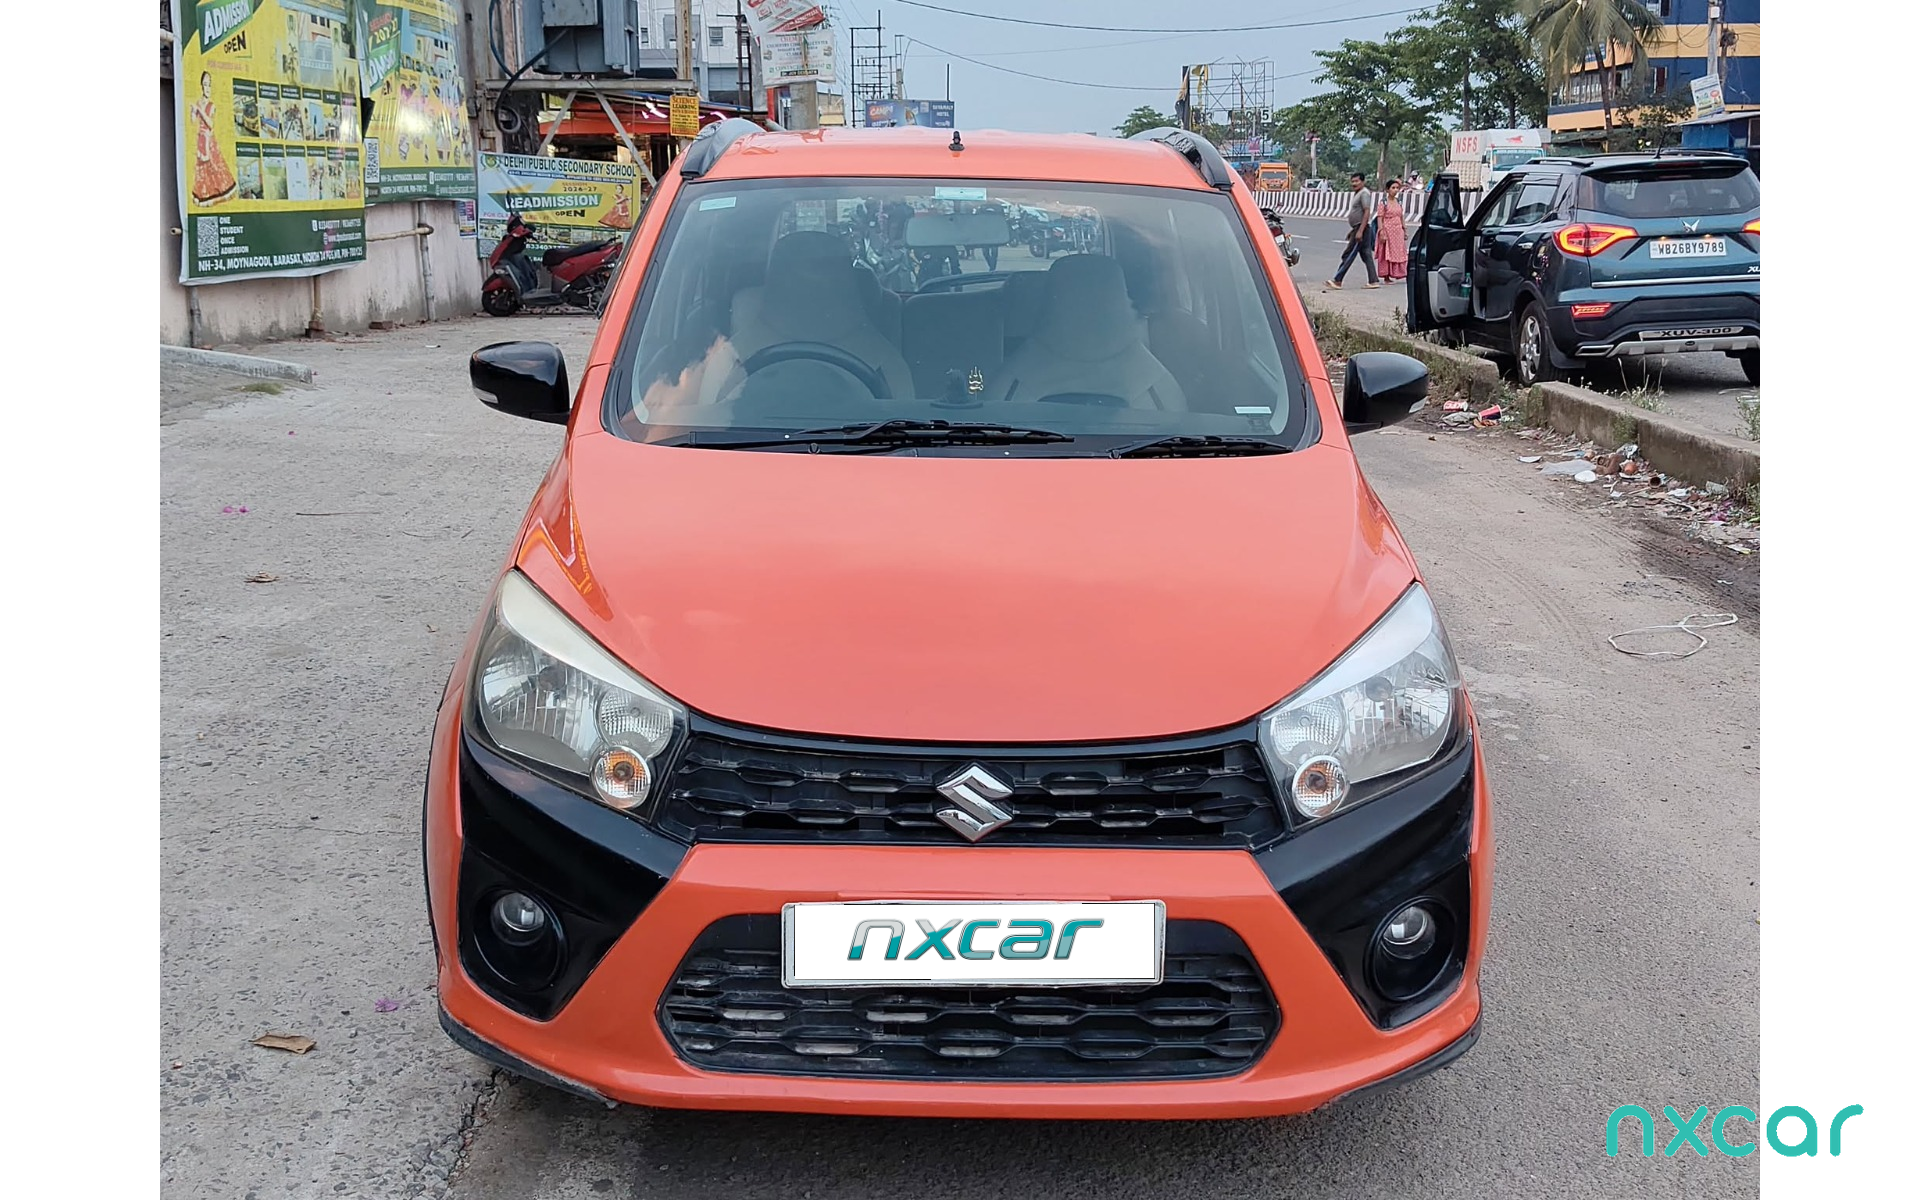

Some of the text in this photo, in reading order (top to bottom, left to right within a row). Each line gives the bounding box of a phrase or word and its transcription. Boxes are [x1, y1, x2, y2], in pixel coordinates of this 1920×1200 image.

[223, 30, 247, 54] OPEN
[1455, 136, 1478, 154] NSFS
[504, 155, 527, 168] DELHI
[528, 158, 556, 171] PUBLIC
[558, 160, 604, 175] SECONDARY
[605, 164, 637, 177] SCHOOL
[555, 209, 586, 217] OPEN
[219, 216, 231, 225] ONE
[219, 226, 244, 235] STUDENT
[220, 236, 235, 245] ONCE
[220, 245, 249, 255] ADMISSION
[1658, 241, 1724, 255] WB26BY9789
[198, 259, 226, 272] NH-34,
[1661, 327, 1732, 337] XUV-300
